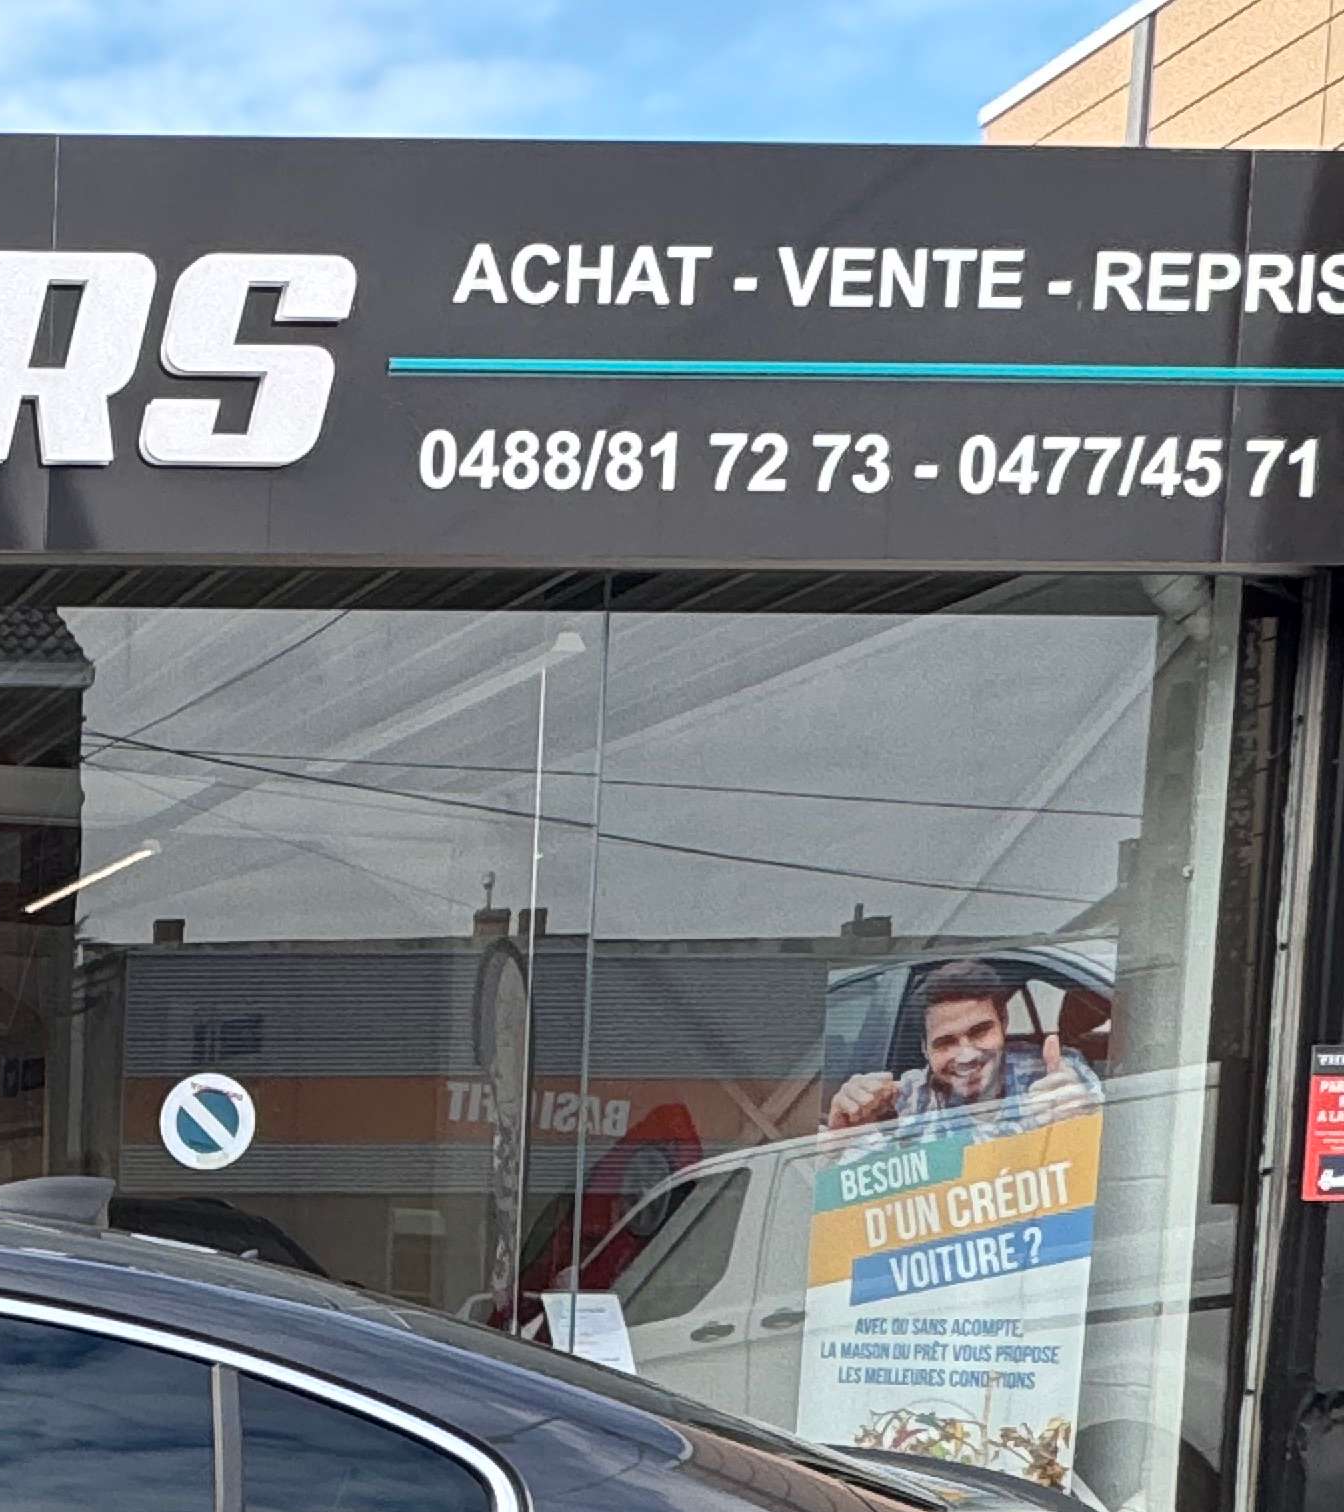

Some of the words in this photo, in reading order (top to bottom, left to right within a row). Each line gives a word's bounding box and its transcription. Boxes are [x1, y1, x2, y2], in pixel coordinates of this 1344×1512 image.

[452, 242, 714, 306] ACHAT
[778, 246, 1026, 310] VENTE
[419, 428, 678, 492] 0488/81
[708, 432, 789, 492] 72
[812, 433, 891, 494] 73
[958, 434, 1224, 498] 0477/45
[1246, 438, 1318, 498] 71
[840, 1149, 930, 1201] BESOIN
[864, 1192, 942, 1249] D'UN
[946, 1160, 1073, 1229] CRÉDIT
[889, 1231, 1019, 1292] VOITURE
[1022, 1225, 1043, 1265] ?
[820, 1341, 837, 1359] LA
[840, 1341, 890, 1360] MAISON
[952, 1344, 992, 1363] VOUS
[995, 1345, 1060, 1364] PROPOSE
[854, 1318, 888, 1336] AVEC
[912, 1319, 948, 1336] SANS
[838, 1366, 862, 1384] LES
[864, 1367, 946, 1387] MEILLEURES
